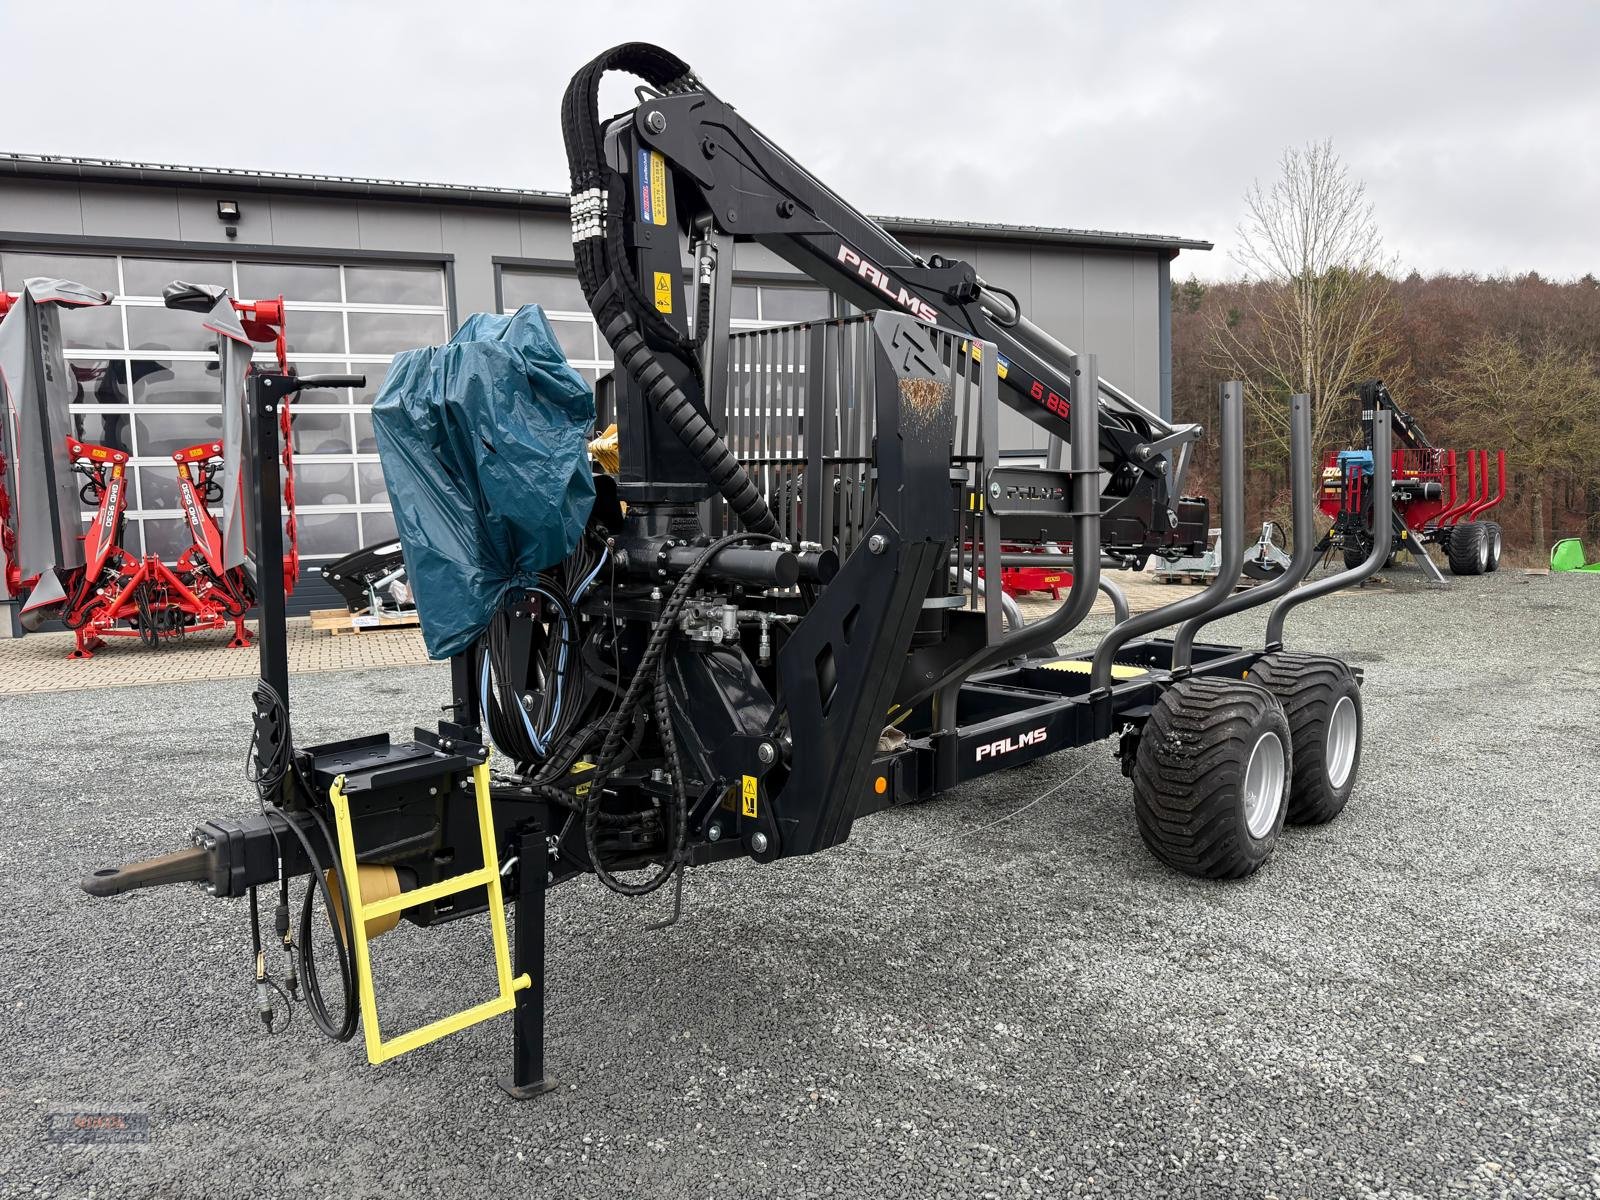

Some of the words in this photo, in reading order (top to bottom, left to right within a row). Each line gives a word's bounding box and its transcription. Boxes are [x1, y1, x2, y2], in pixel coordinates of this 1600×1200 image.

[838, 244, 938, 325] PALMS
[1030, 380, 1070, 418] 5.85
[109, 484, 119, 503] GMD
[181, 483, 193, 505] 9530
[1006, 485, 1065, 501] PALMS
[105, 505, 115, 527] 9530
[188, 506, 199, 525] GMD
[975, 727, 1048, 762] PALMS
